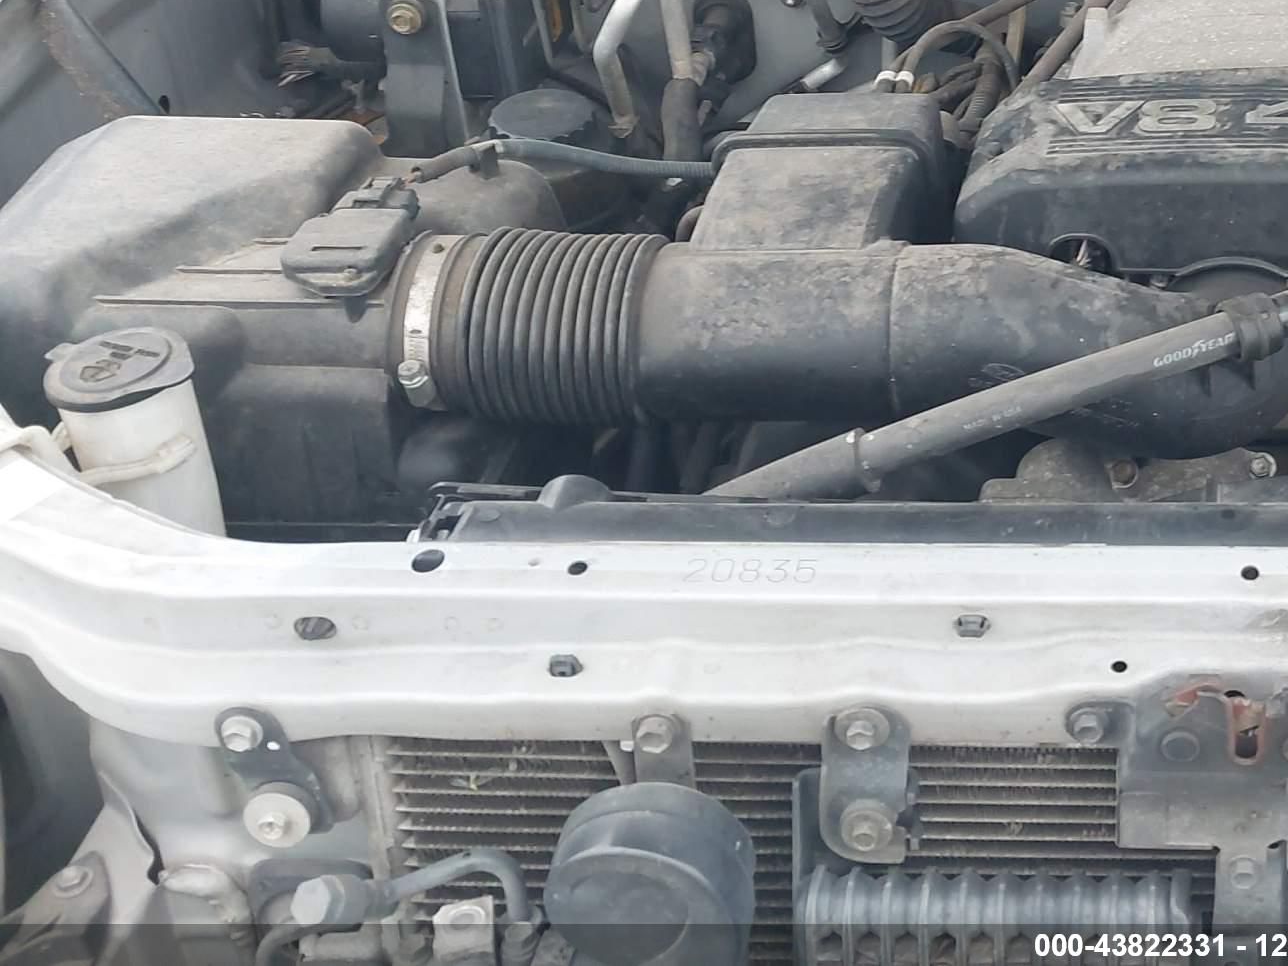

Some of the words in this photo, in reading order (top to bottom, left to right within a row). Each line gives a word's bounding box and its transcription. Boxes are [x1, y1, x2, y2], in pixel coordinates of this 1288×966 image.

[1053, 99, 1218, 134] V8
[1153, 332, 1235, 367] GOODYEAR
[682, 558, 819, 583] 20835
